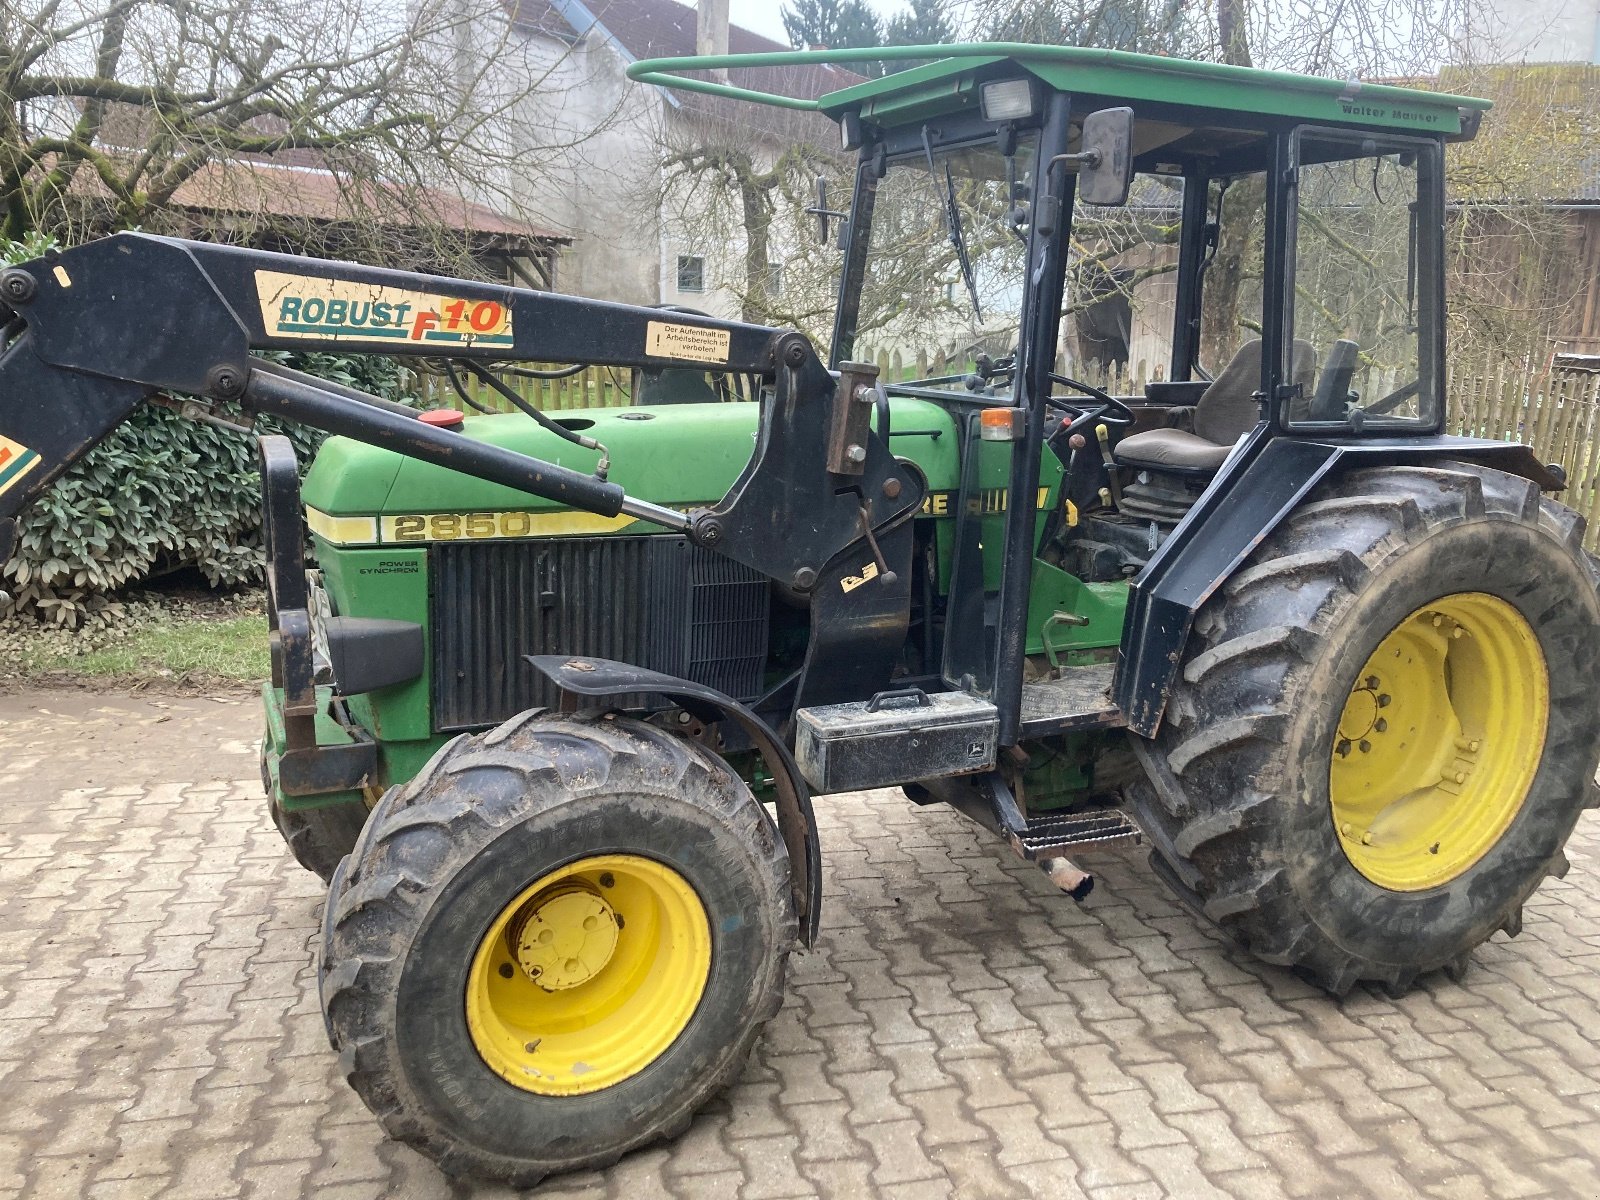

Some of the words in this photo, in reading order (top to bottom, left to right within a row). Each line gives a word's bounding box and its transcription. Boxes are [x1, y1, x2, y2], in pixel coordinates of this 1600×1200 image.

[1342, 105, 1386, 117] Walter
[279, 296, 411, 327] ROBUST
[411, 300, 502, 340] F10
[664, 325, 678, 333] Der
[679, 327, 716, 337] Aufenthalt
[665, 333, 718, 346] Arbeitsbereich
[682, 344, 716, 353] verboten!
[394, 512, 531, 541] 2850
[360, 567, 419, 575] SYNCHRON
